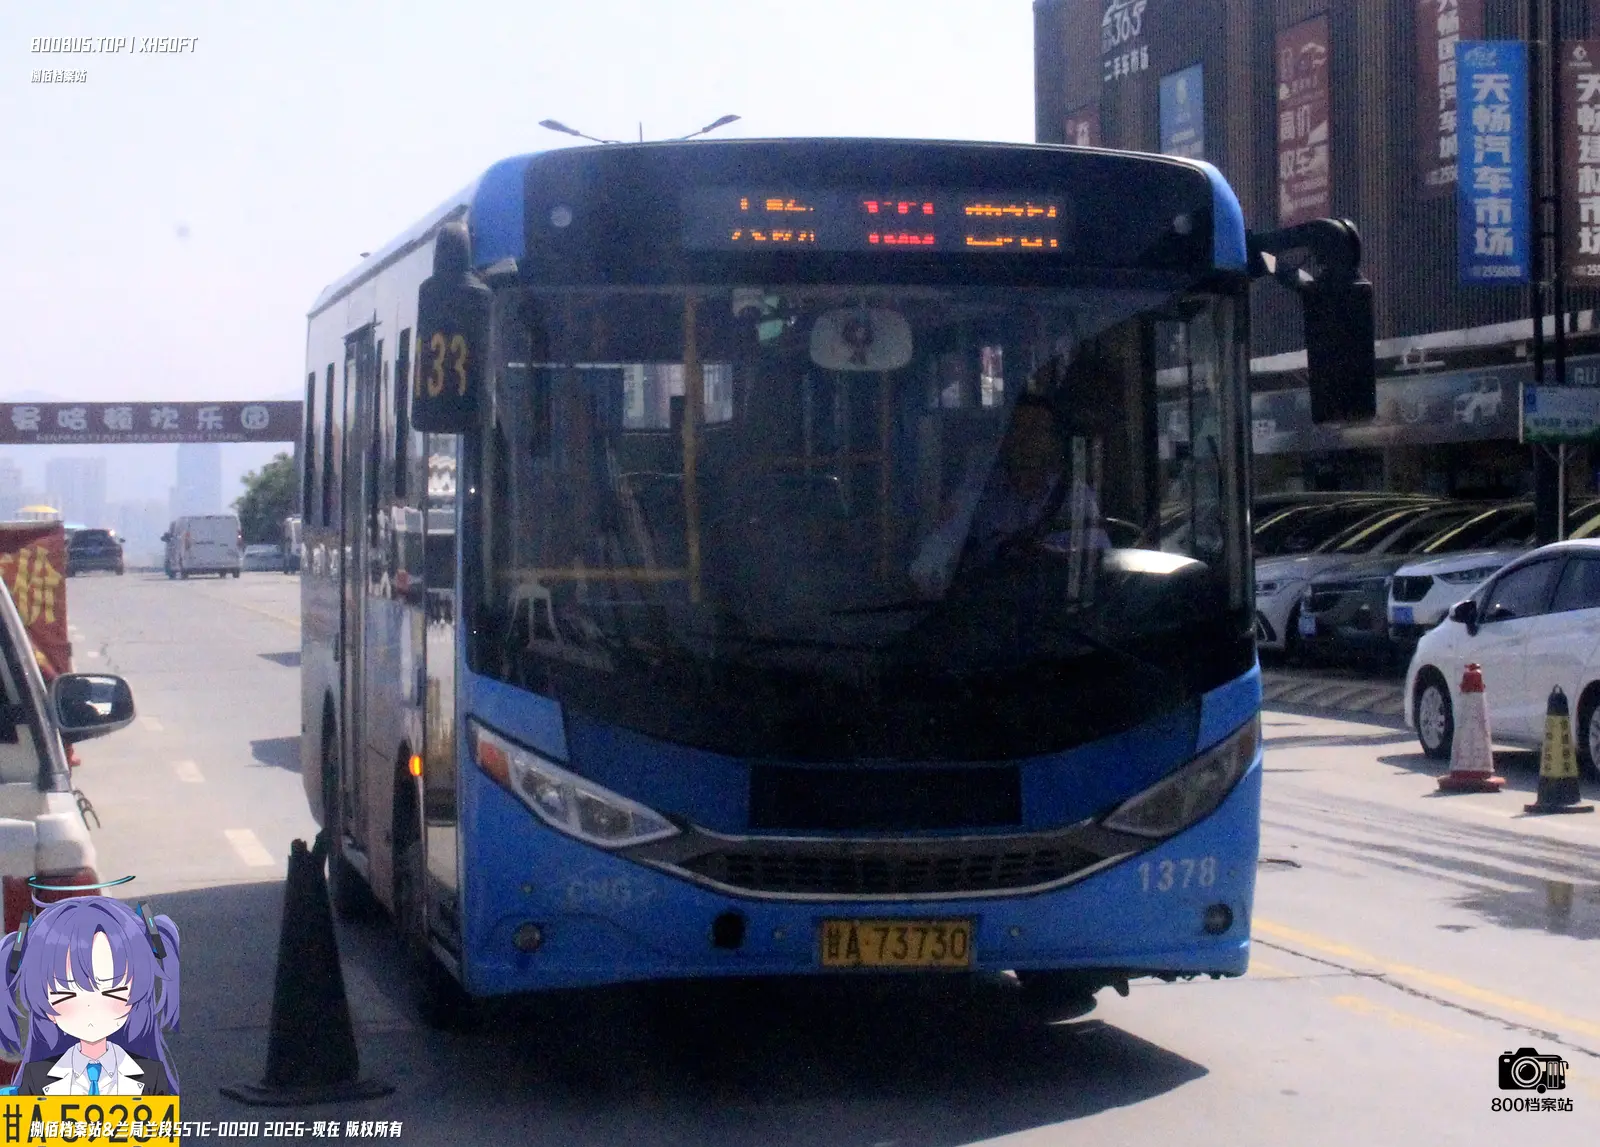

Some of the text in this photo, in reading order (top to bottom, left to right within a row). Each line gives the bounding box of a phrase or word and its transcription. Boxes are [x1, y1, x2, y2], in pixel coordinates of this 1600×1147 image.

[1471, 74, 1514, 256] 天畅汽车市场
[1139, 857, 1217, 892] 1378
